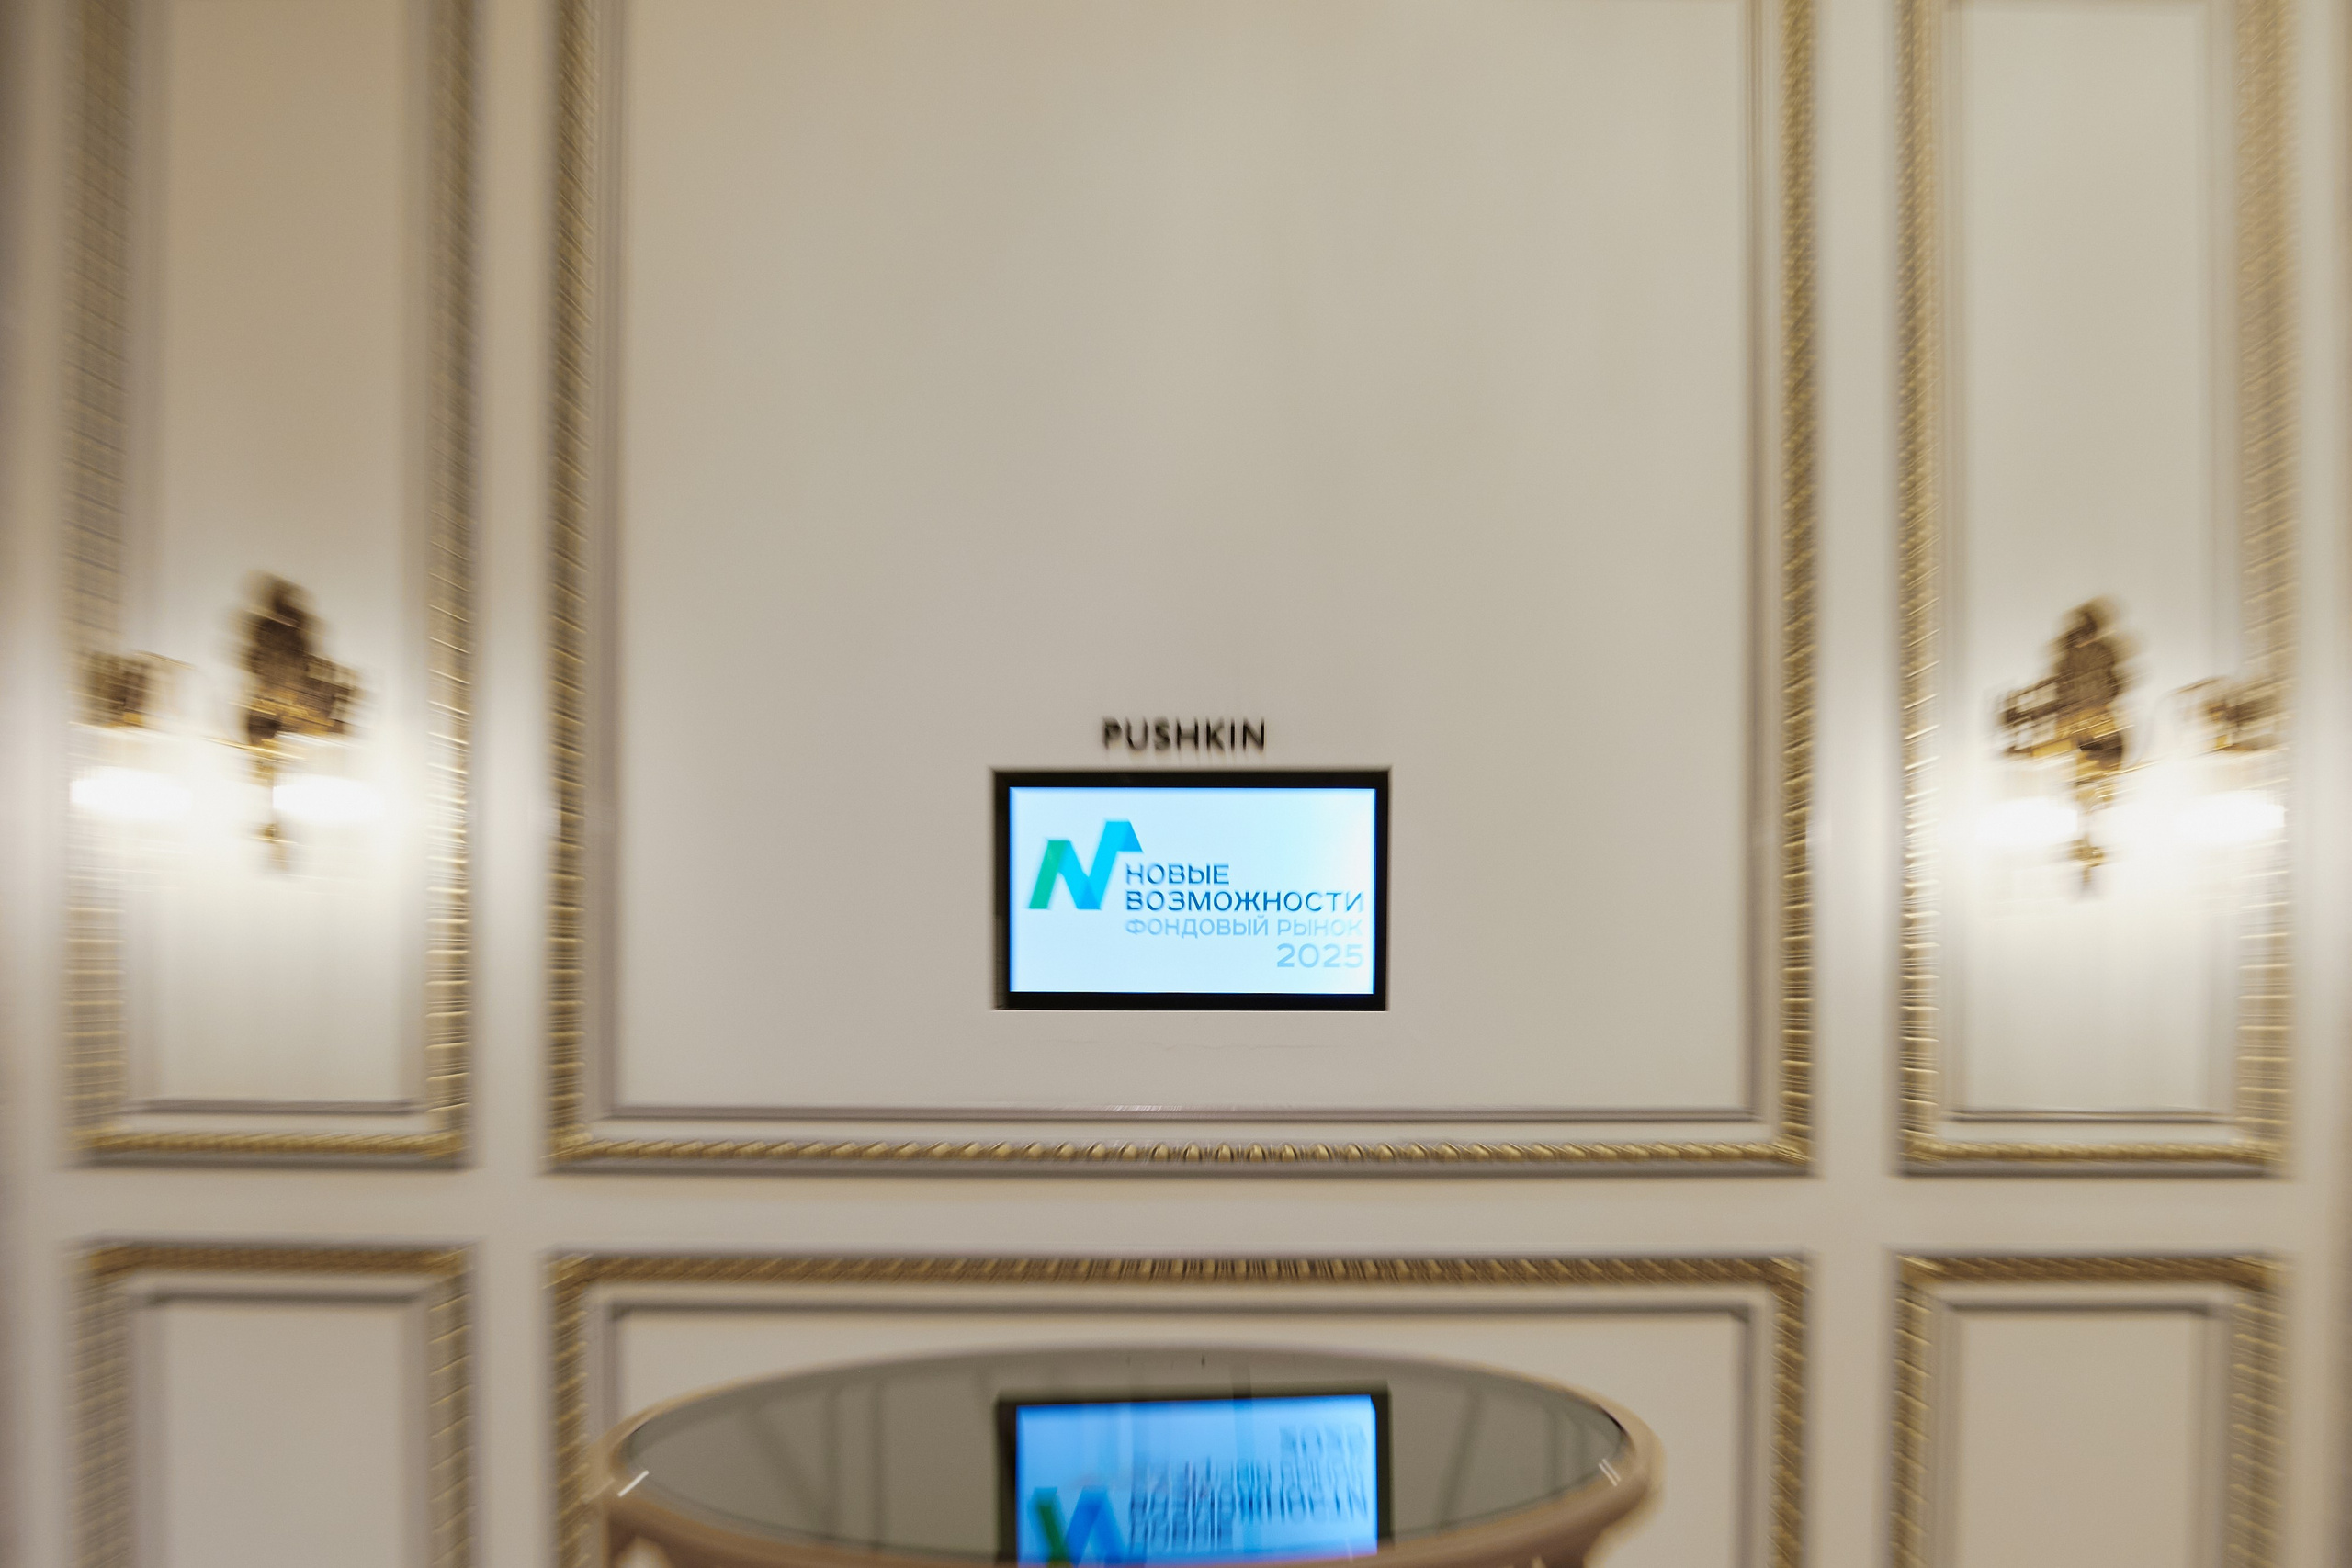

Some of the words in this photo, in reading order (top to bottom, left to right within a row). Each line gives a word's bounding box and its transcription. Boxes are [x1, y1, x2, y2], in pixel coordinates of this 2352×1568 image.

[1102, 716, 1266, 752] PUSHKIN
[1125, 863, 1230, 886] НОВЫЕ
[1125, 890, 1364, 912] ВОЗМОЖНОСТИ
[1125, 915, 1270, 938] ФОНДОВЫЙ
[1277, 919, 1363, 937] РЫНОК
[1276, 943, 1364, 969] 2025
